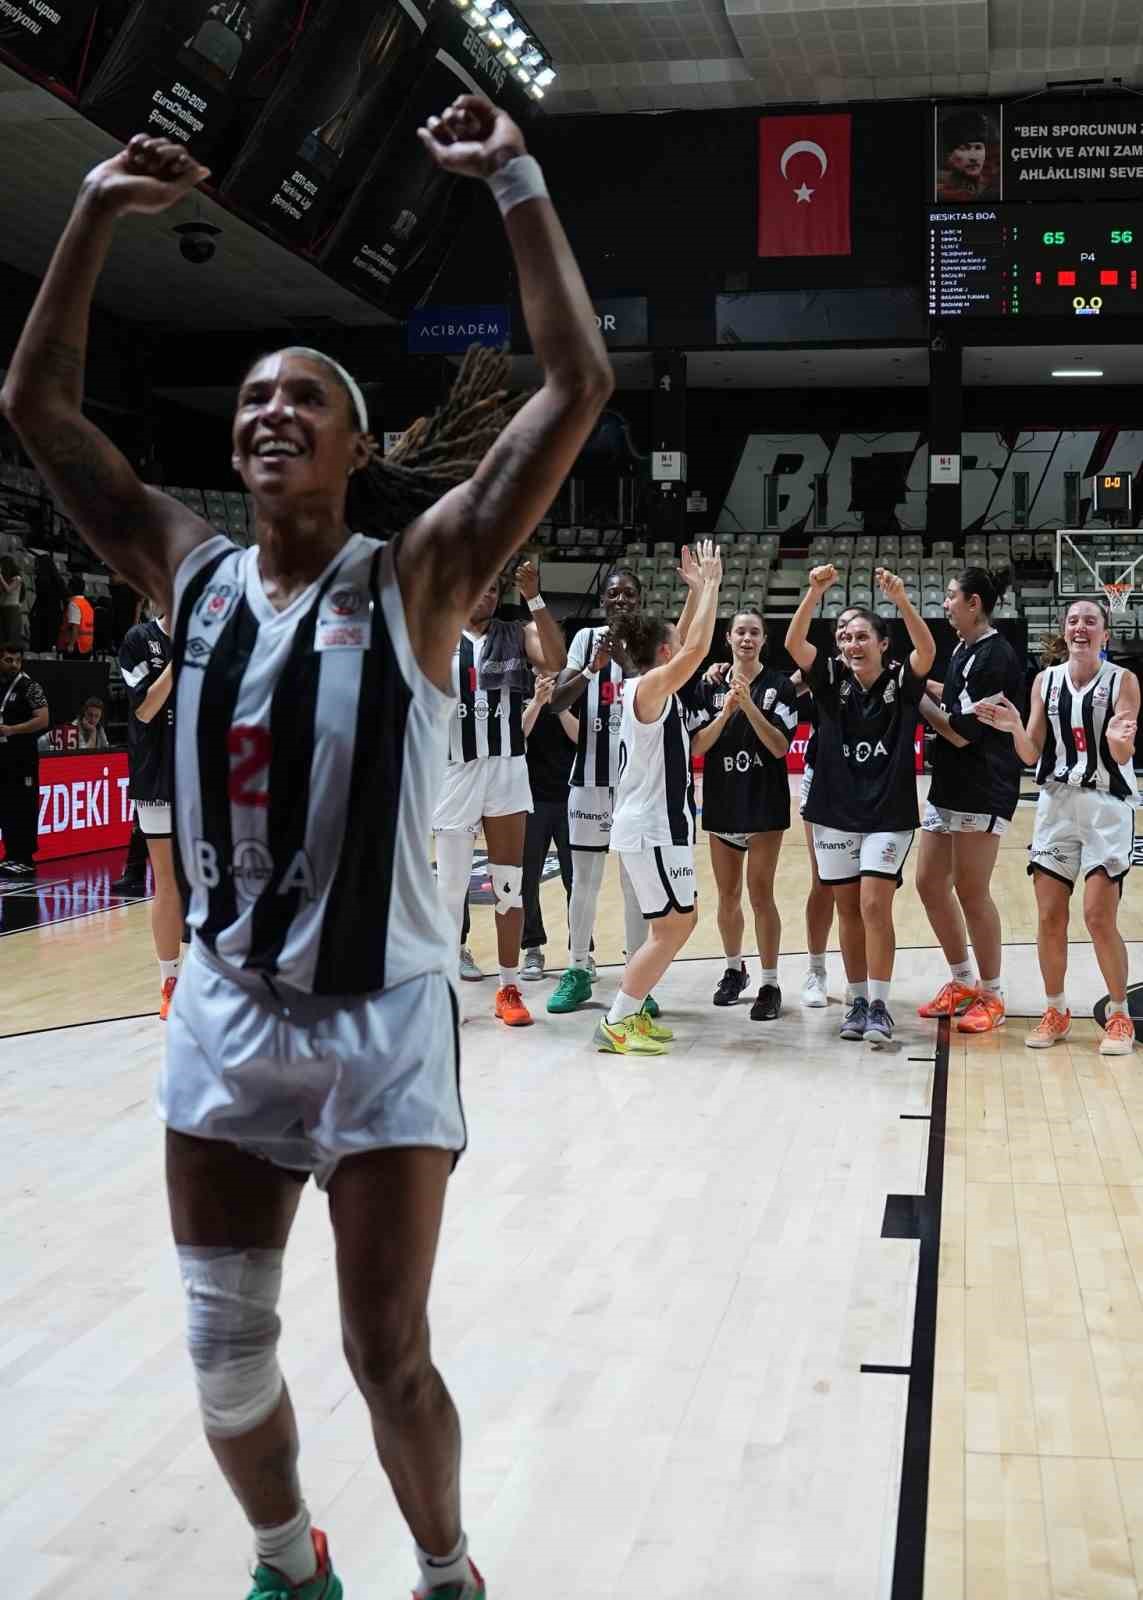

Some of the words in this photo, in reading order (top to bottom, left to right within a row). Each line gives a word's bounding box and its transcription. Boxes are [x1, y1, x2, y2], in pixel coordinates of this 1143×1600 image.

[1052, 123, 1137, 137] SPORCUNUN
[1011, 145, 1052, 161] ÇEVİK
[1056, 147, 1074, 158] VE
[1078, 145, 1110, 157] AYNI
[1042, 231, 1066, 245] 65
[1110, 230, 1133, 244] 56
[1080, 252, 1096, 262] P4
[1073, 296, 1103, 309] 0.0
[226, 726, 273, 807] 2
[723, 751, 764, 773] BOA
